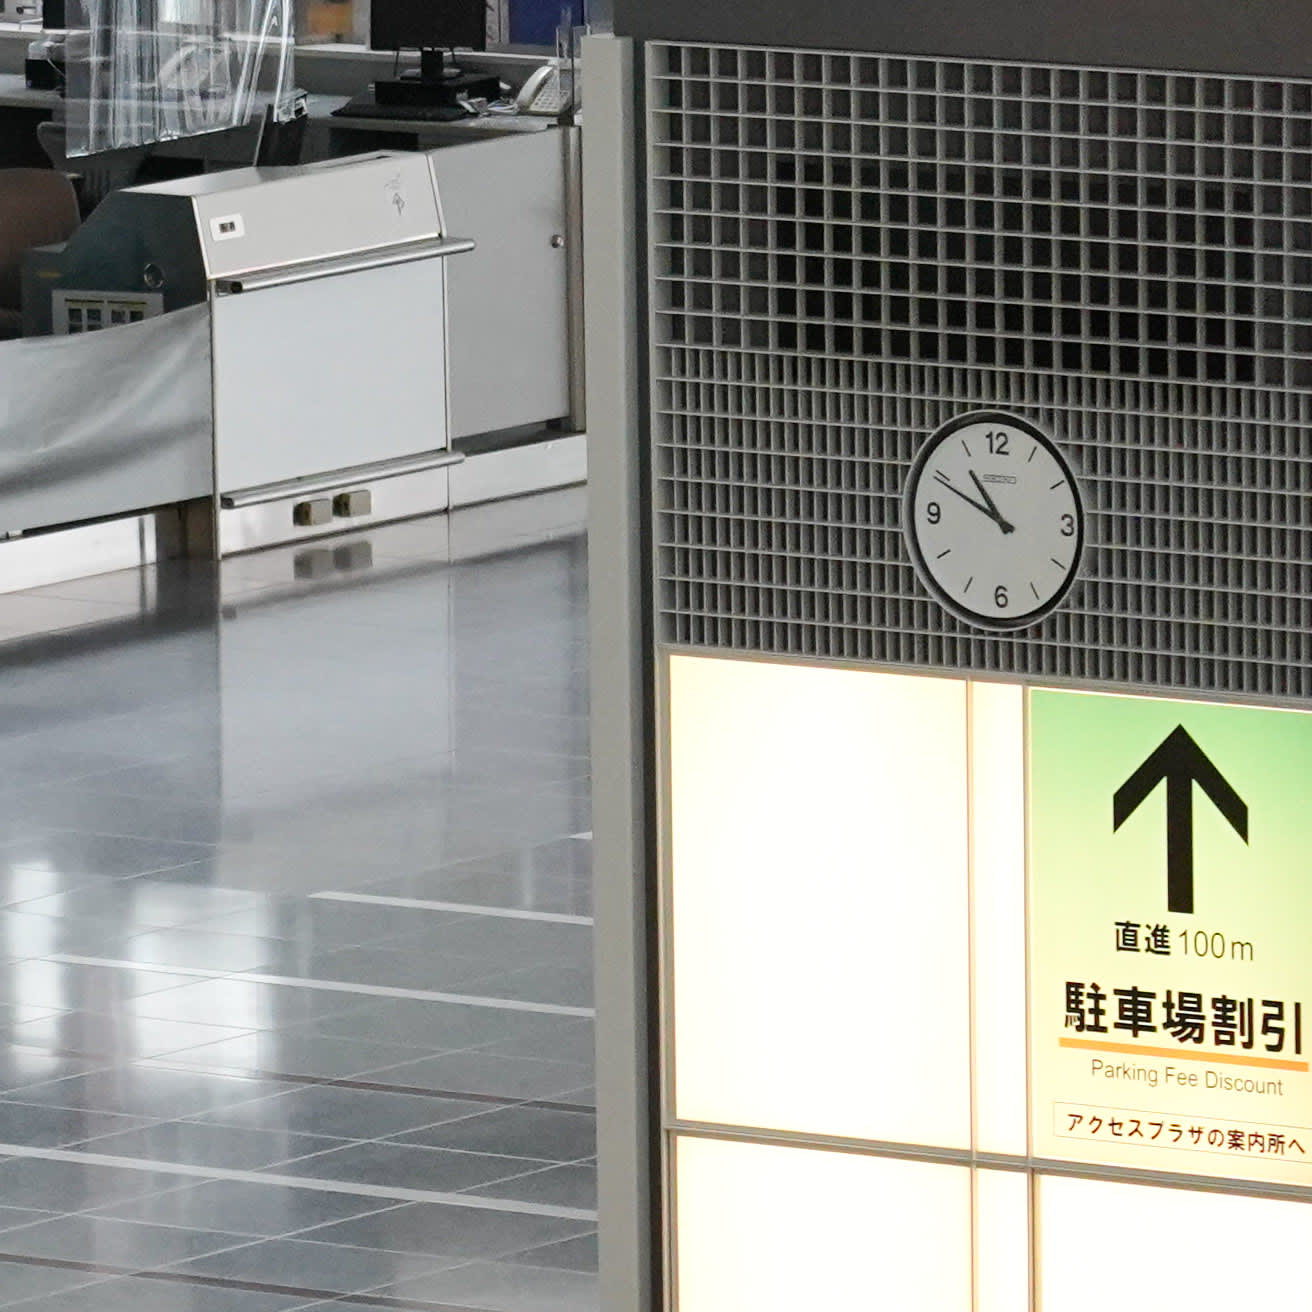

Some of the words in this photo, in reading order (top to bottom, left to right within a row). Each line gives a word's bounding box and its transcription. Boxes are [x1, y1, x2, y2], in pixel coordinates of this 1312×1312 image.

[985, 431, 1010, 455] 12
[927, 502, 941, 525] 9
[1060, 513, 1075, 536] 3
[994, 585, 1008, 608] 6
[1064, 980, 1302, 1055] 駐車場割引
[1091, 1058, 1158, 1088] Parking
[1165, 1066, 1198, 1088] Fee
[1205, 1070, 1283, 1097] Discount
[1067, 1112, 1306, 1156] アクセスプラザの案内所へ
